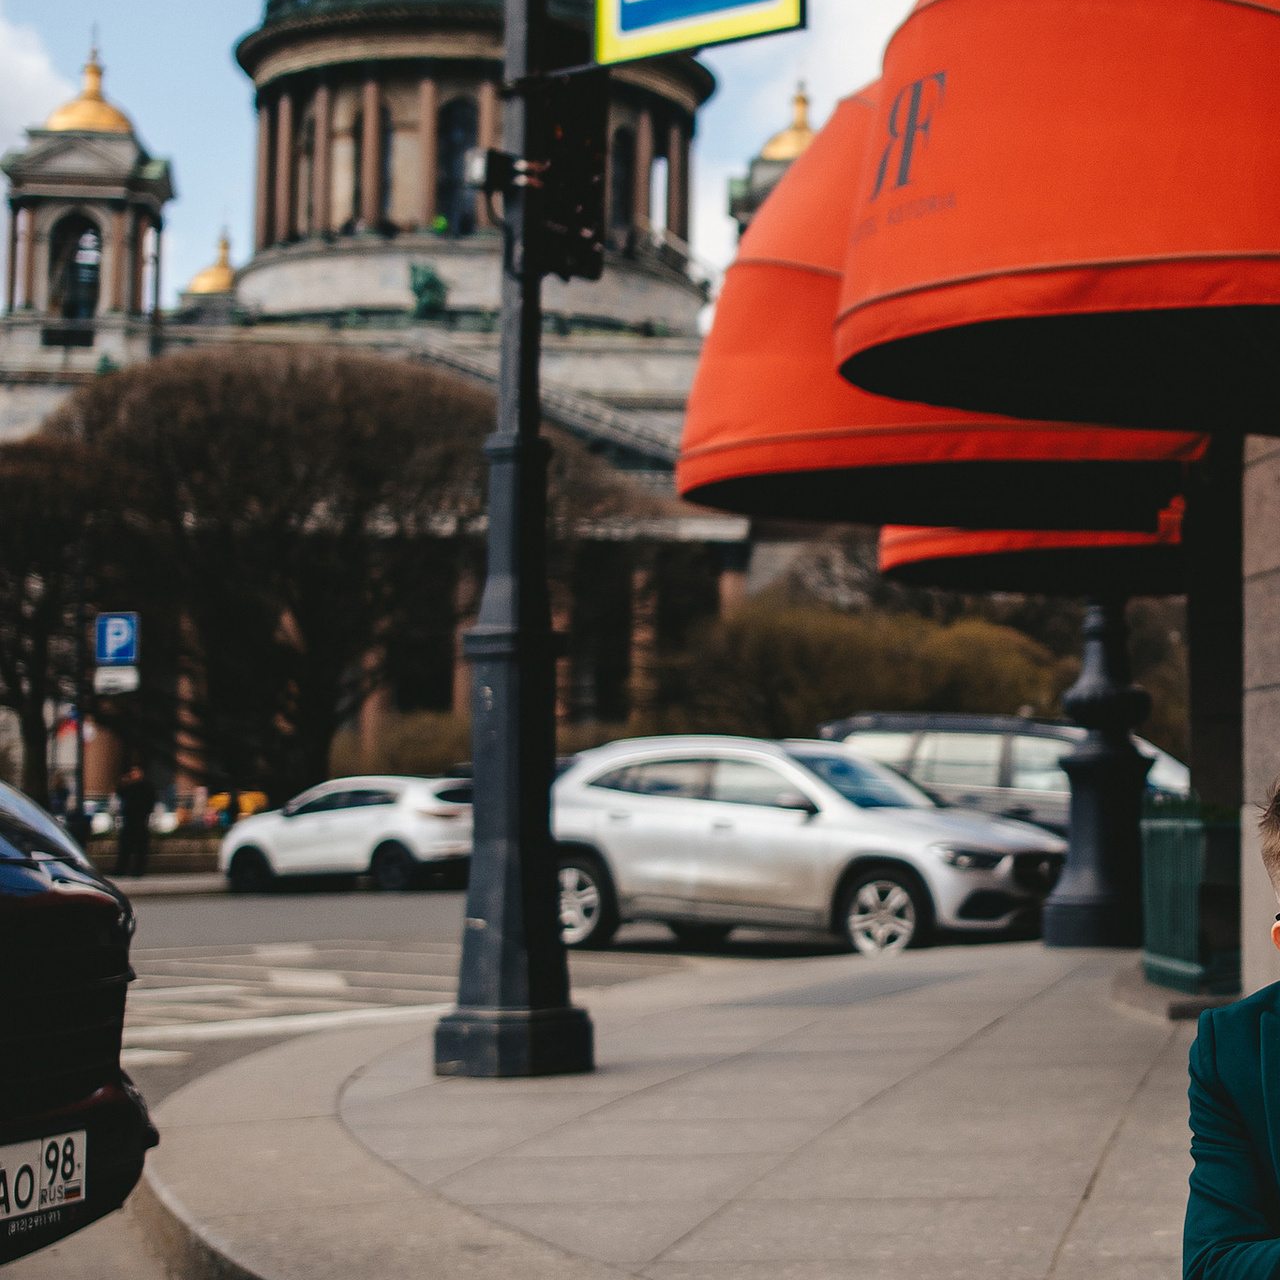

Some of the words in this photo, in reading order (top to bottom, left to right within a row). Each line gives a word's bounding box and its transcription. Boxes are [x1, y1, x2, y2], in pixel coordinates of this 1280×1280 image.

[106, 618, 132, 656] P
[45, 1137, 74, 1185] 98
[40, 1185, 64, 1204] RUS
